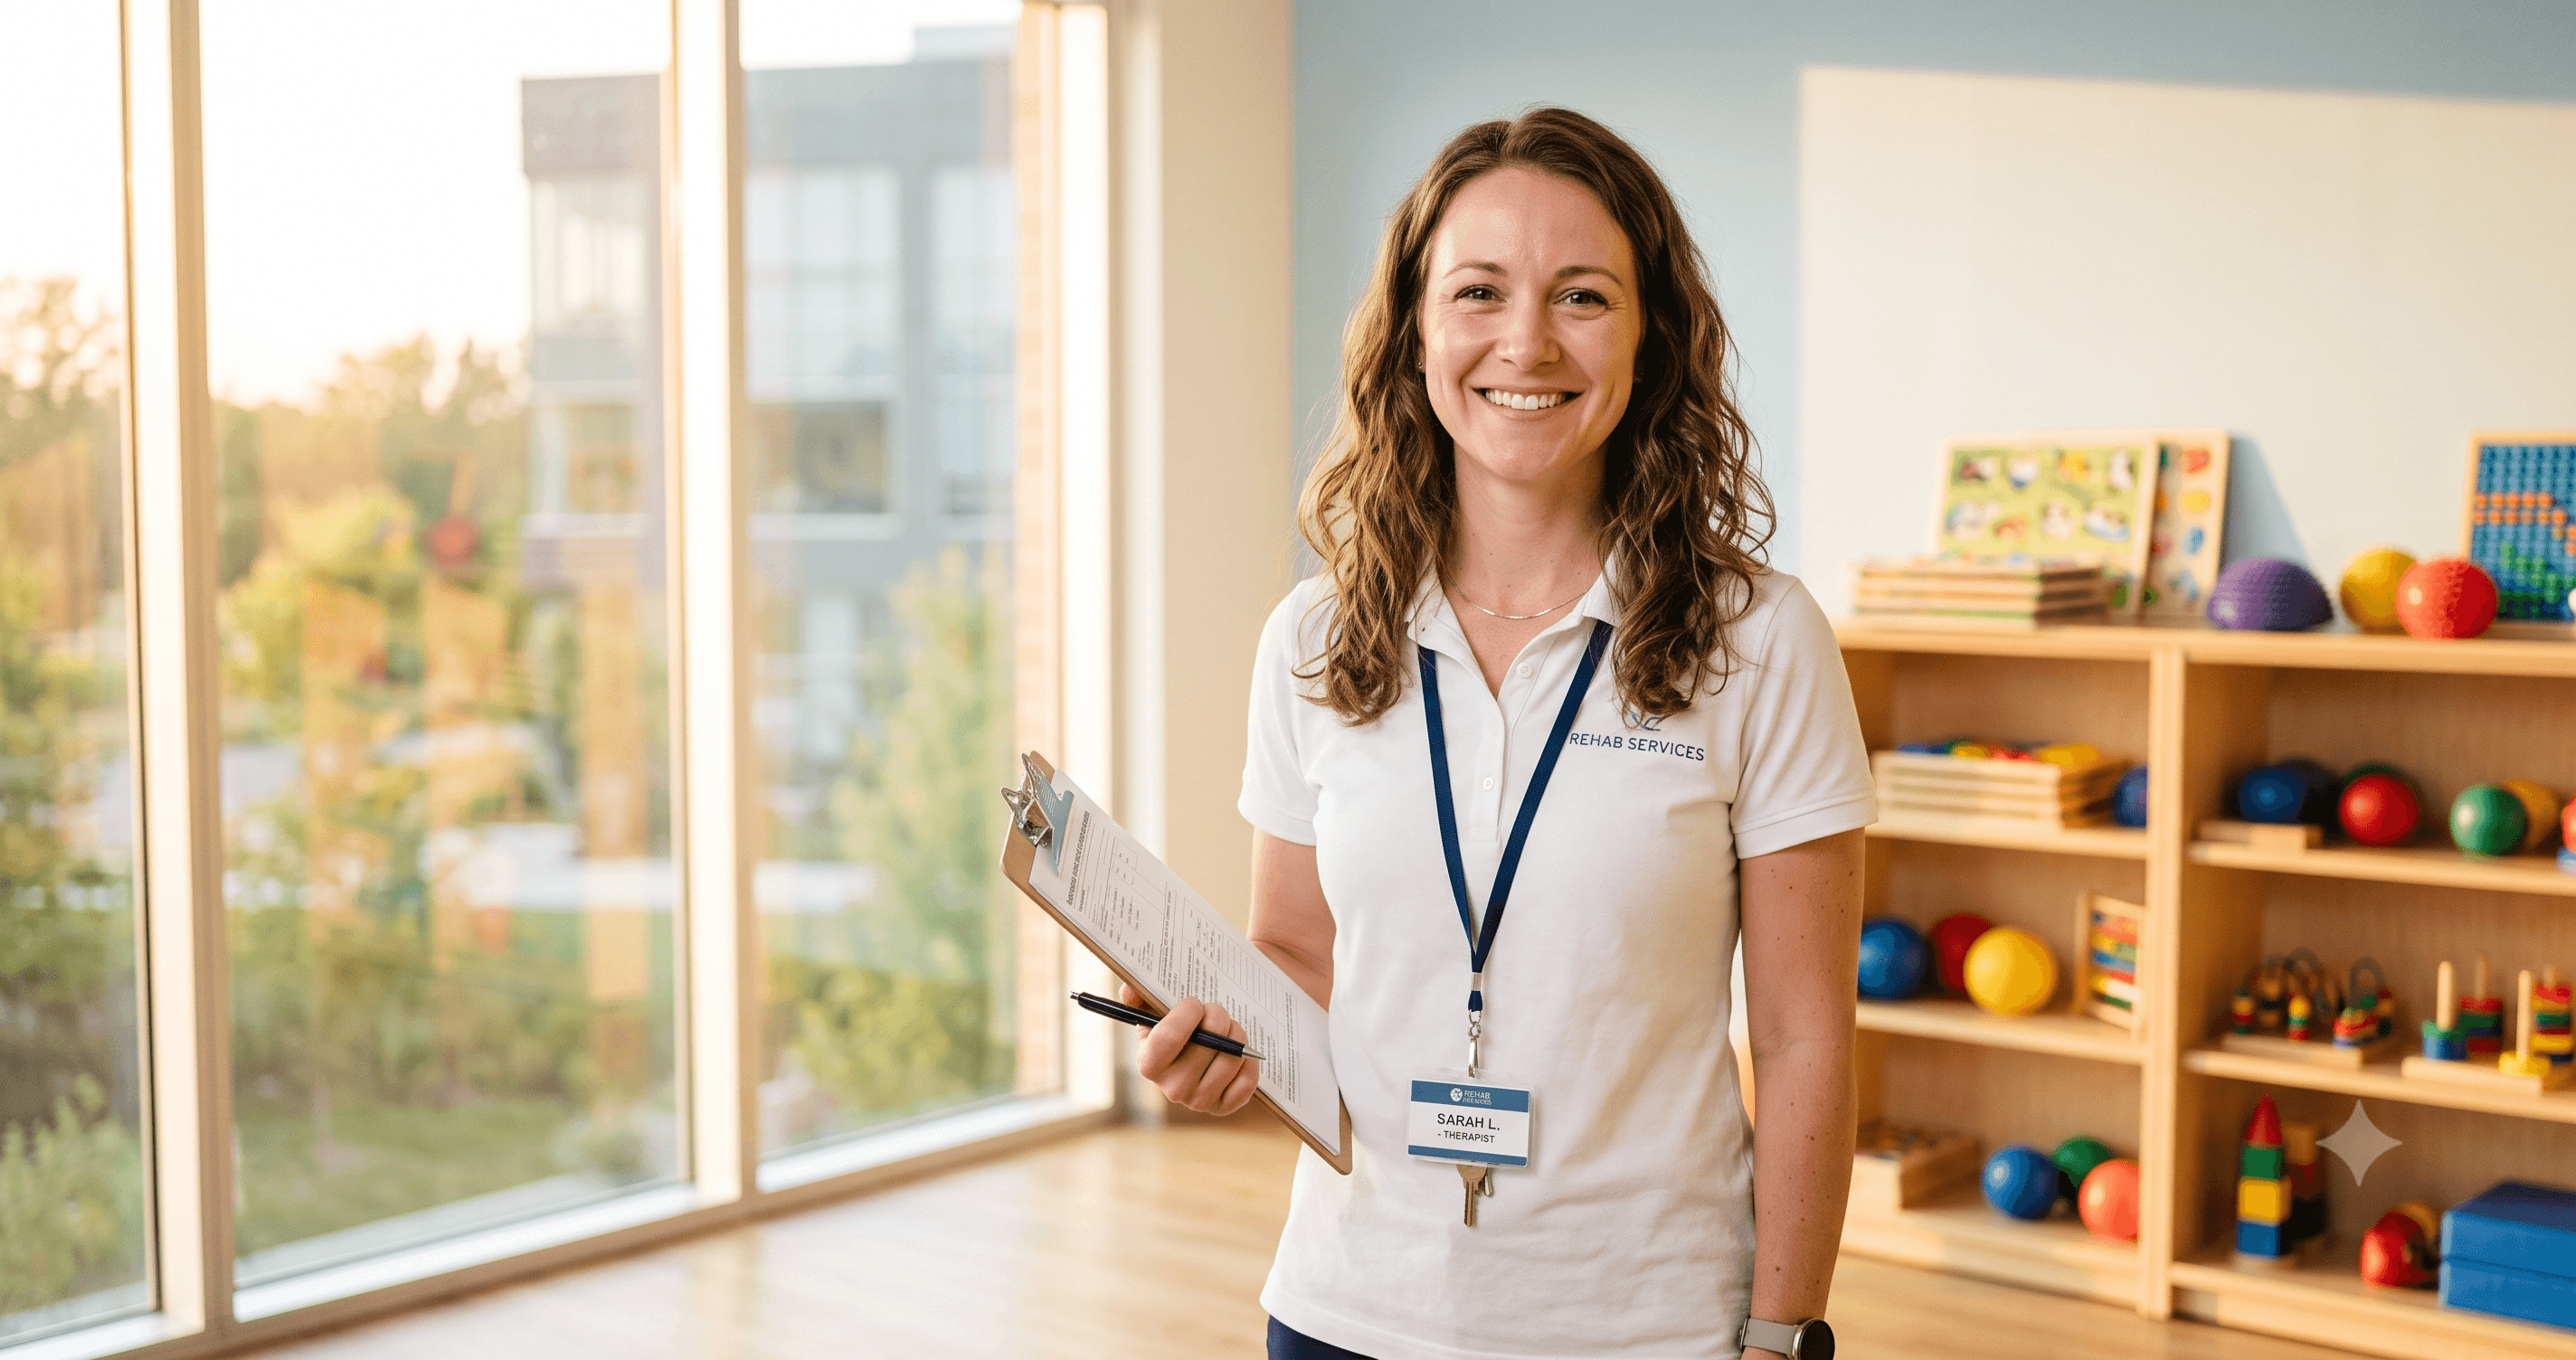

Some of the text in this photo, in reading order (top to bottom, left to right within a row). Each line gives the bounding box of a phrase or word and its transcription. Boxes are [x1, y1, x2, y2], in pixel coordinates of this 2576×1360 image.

[1569, 733, 1705, 761] REHAB SERVICES
[1464, 1090, 1491, 1099] REHAB
[1437, 1113, 1500, 1130] SARAH L.
[1444, 1130, 1495, 1143] THERAPIST
